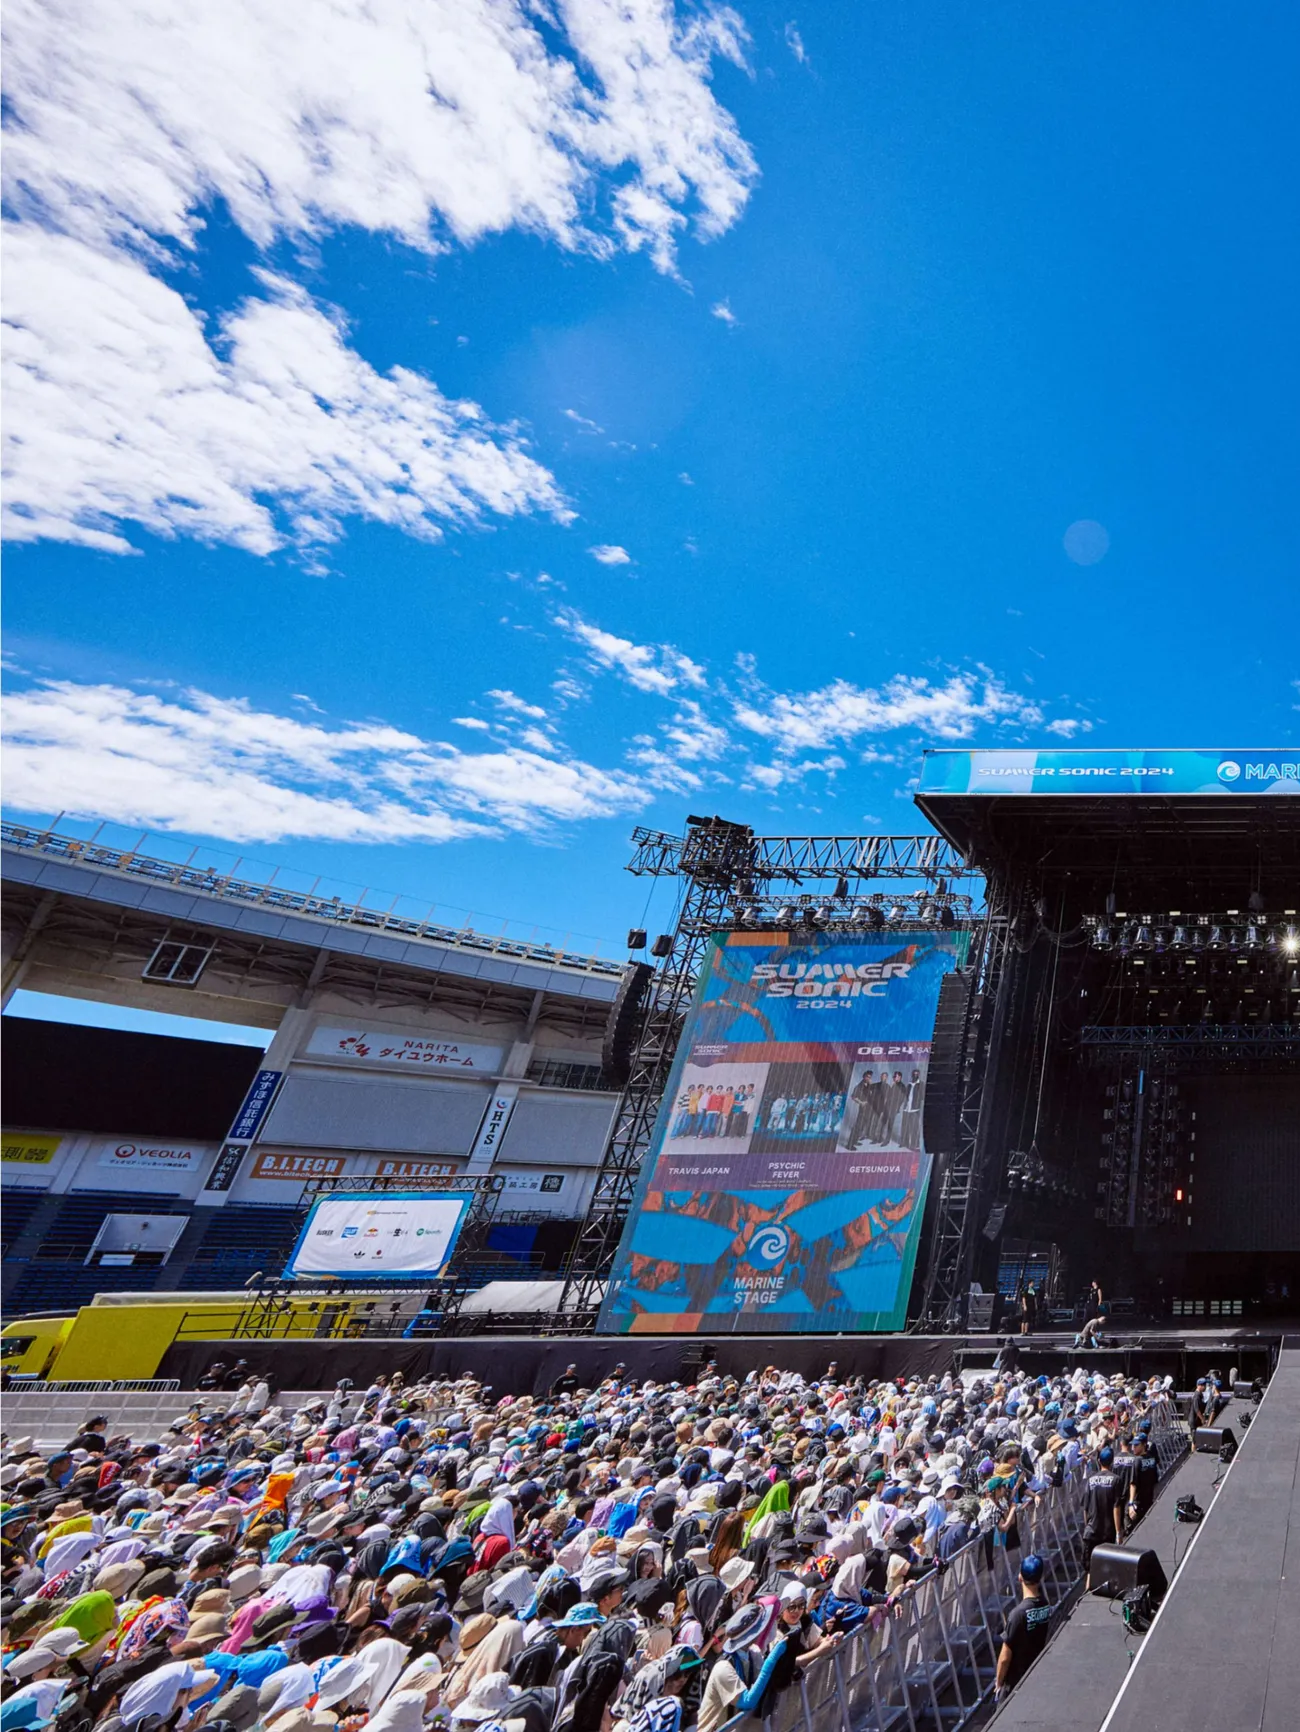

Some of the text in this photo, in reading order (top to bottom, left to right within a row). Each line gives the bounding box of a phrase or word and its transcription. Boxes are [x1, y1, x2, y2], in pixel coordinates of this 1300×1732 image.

[977, 767, 1175, 777] SUMMER SONIC 2024
[751, 963, 913, 979] SUMMER
[765, 981, 889, 998] SONIC
[795, 1000, 853, 1009] 2024
[404, 1040, 459, 1053] NARITA
[857, 1046, 915, 1055] 08.24
[378, 1048, 474, 1067] ダイユウホーム
[235, 1072, 275, 1137] みずほ信託銀行
[483, 1111, 504, 1145] HTS
[139, 1149, 192, 1160] VEOLIA
[261, 1156, 339, 1174] B.I.TECH
[668, 1166, 730, 1175] TRAVIS JAPAN
[768, 1162, 807, 1170] PSYCHIC
[849, 1165, 901, 1173] GETSUNOVA
[772, 1171, 800, 1179] FEVER
[733, 1276, 785, 1290] MARINE
[733, 1291, 778, 1304] STAGE
